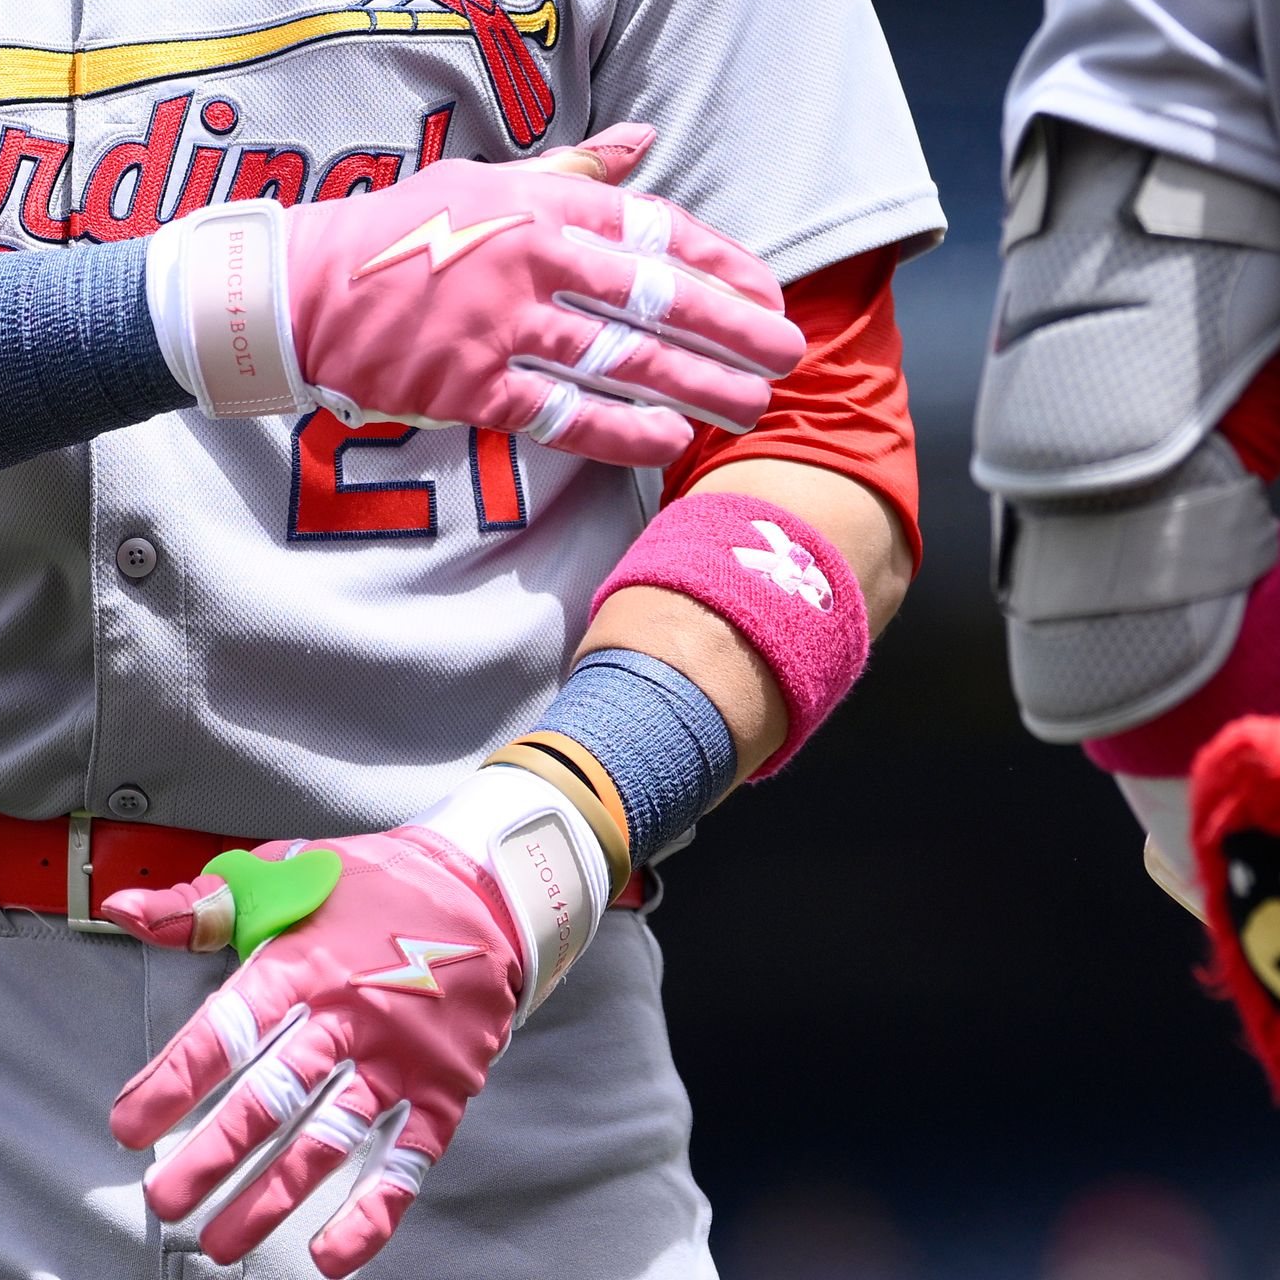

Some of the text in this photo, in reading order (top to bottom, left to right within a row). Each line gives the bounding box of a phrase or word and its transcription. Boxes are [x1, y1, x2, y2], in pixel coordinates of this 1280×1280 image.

[227, 230, 257, 377] BRUCE BOLT
[526, 842, 561, 900] BOLT
